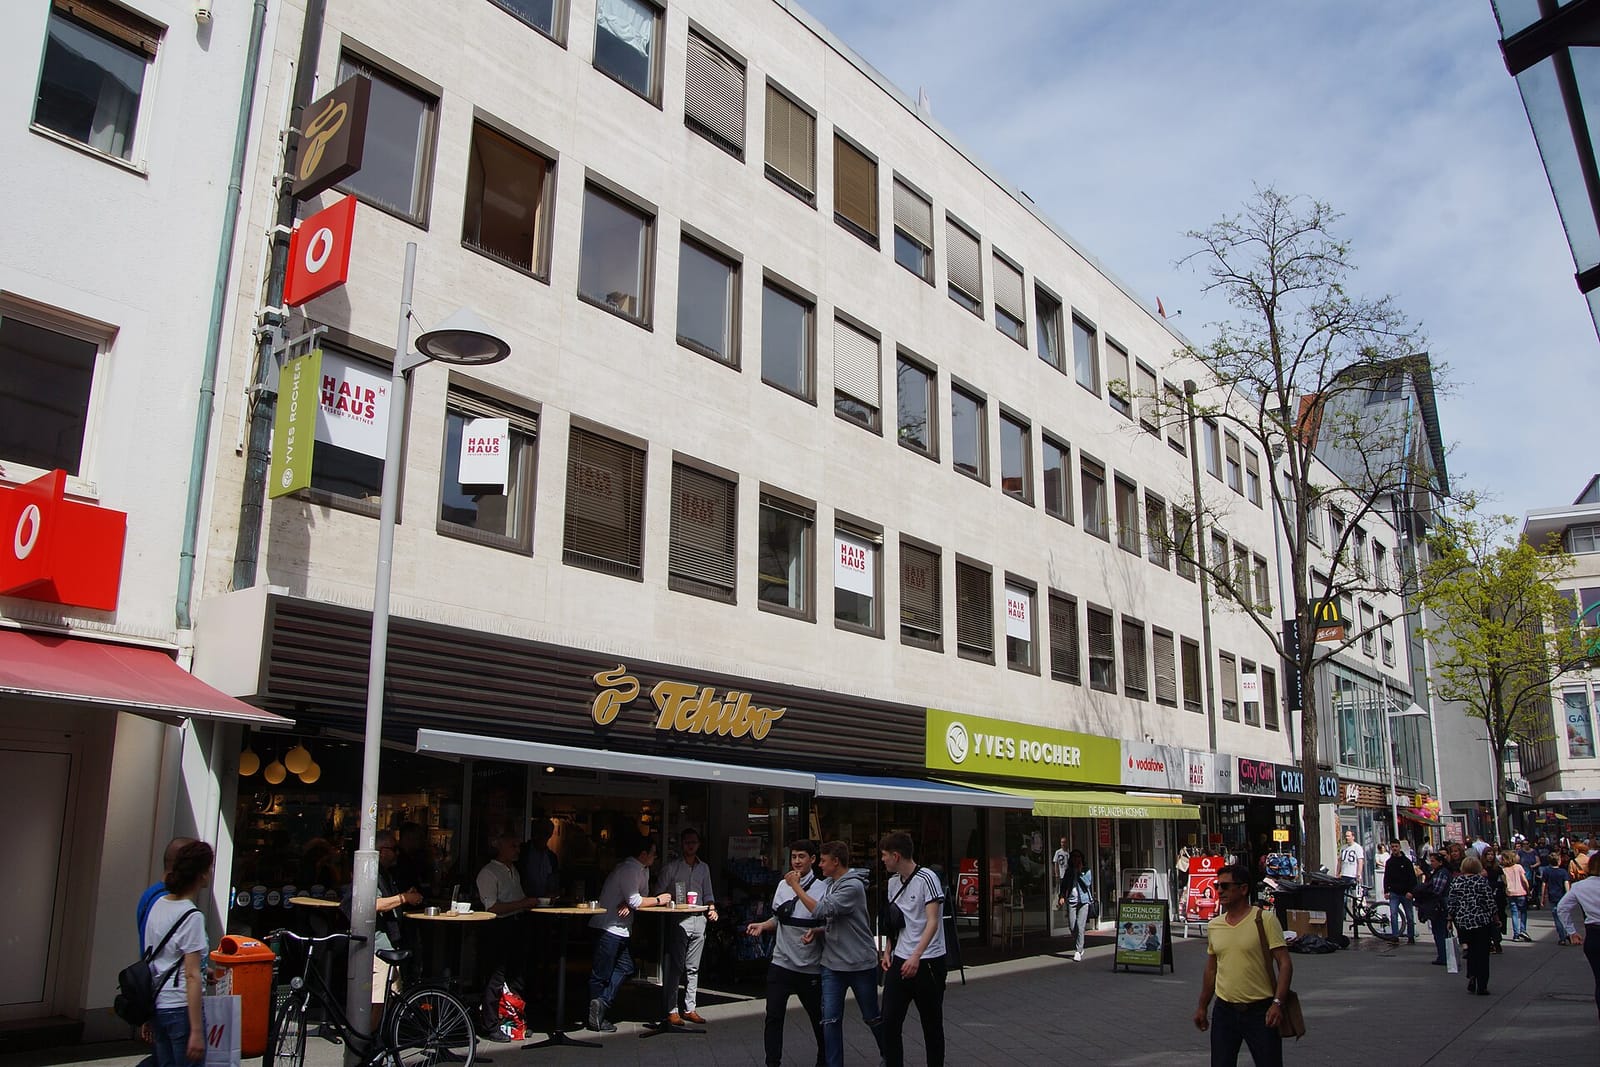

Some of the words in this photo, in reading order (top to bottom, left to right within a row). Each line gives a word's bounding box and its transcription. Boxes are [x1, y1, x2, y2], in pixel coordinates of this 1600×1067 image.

[290, 361, 302, 422] ROCHER
[322, 374, 376, 405] HAIR
[321, 390, 375, 419] HAUS
[347, 413, 374, 425] PARTNER
[286, 426, 295, 464] YVES
[467, 445, 500, 453] HAUS
[468, 437, 500, 446] HAIR
[841, 544, 865, 560] HAIR
[841, 554, 865, 570] HAUS
[1008, 599, 1024, 611] HAIR
[1008, 607, 1025, 620] HAUS
[650, 681, 787, 740] Tchibo
[974, 733, 1015, 759] YVES
[1020, 740, 1080, 768] ROCHER
[1136, 758, 1164, 773] vodafone
[1189, 765, 1203, 774] HAIR
[1241, 760, 1257, 784] City
[1259, 762, 1273, 781] Girl
[1189, 774, 1204, 785] HAUS
[1281, 770, 1304, 793] CRÄ
